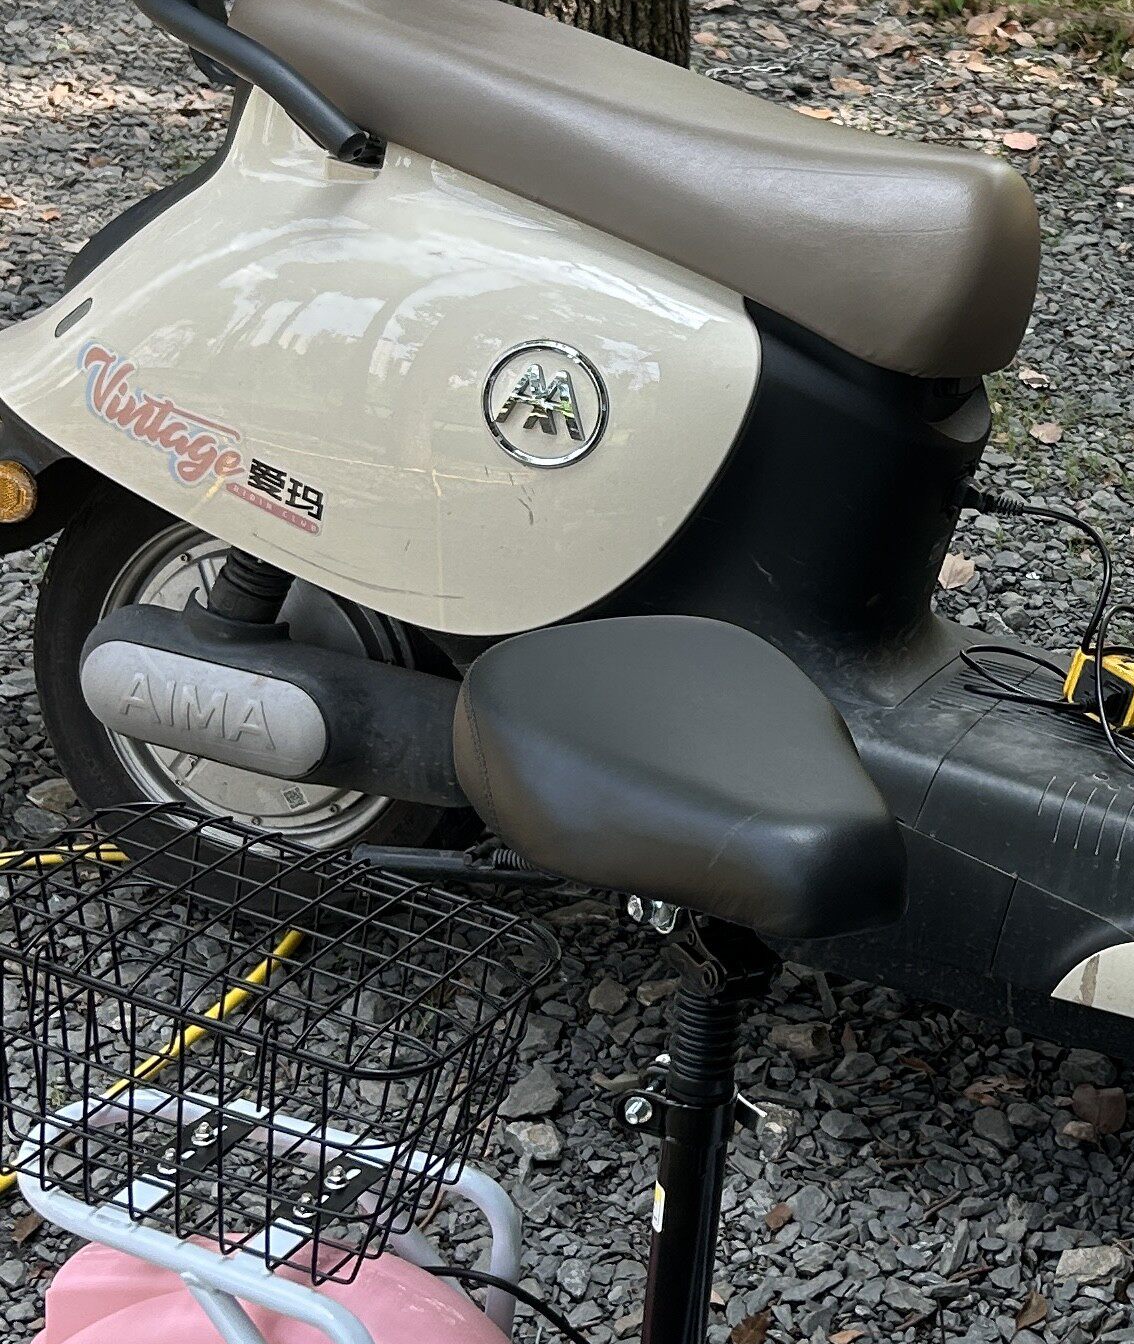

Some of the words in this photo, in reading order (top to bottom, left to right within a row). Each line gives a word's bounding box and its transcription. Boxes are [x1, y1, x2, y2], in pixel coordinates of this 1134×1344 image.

[82, 343, 246, 484] Vintage
[247, 457, 325, 521] 爱玛
[118, 671, 276, 752] AIMA
